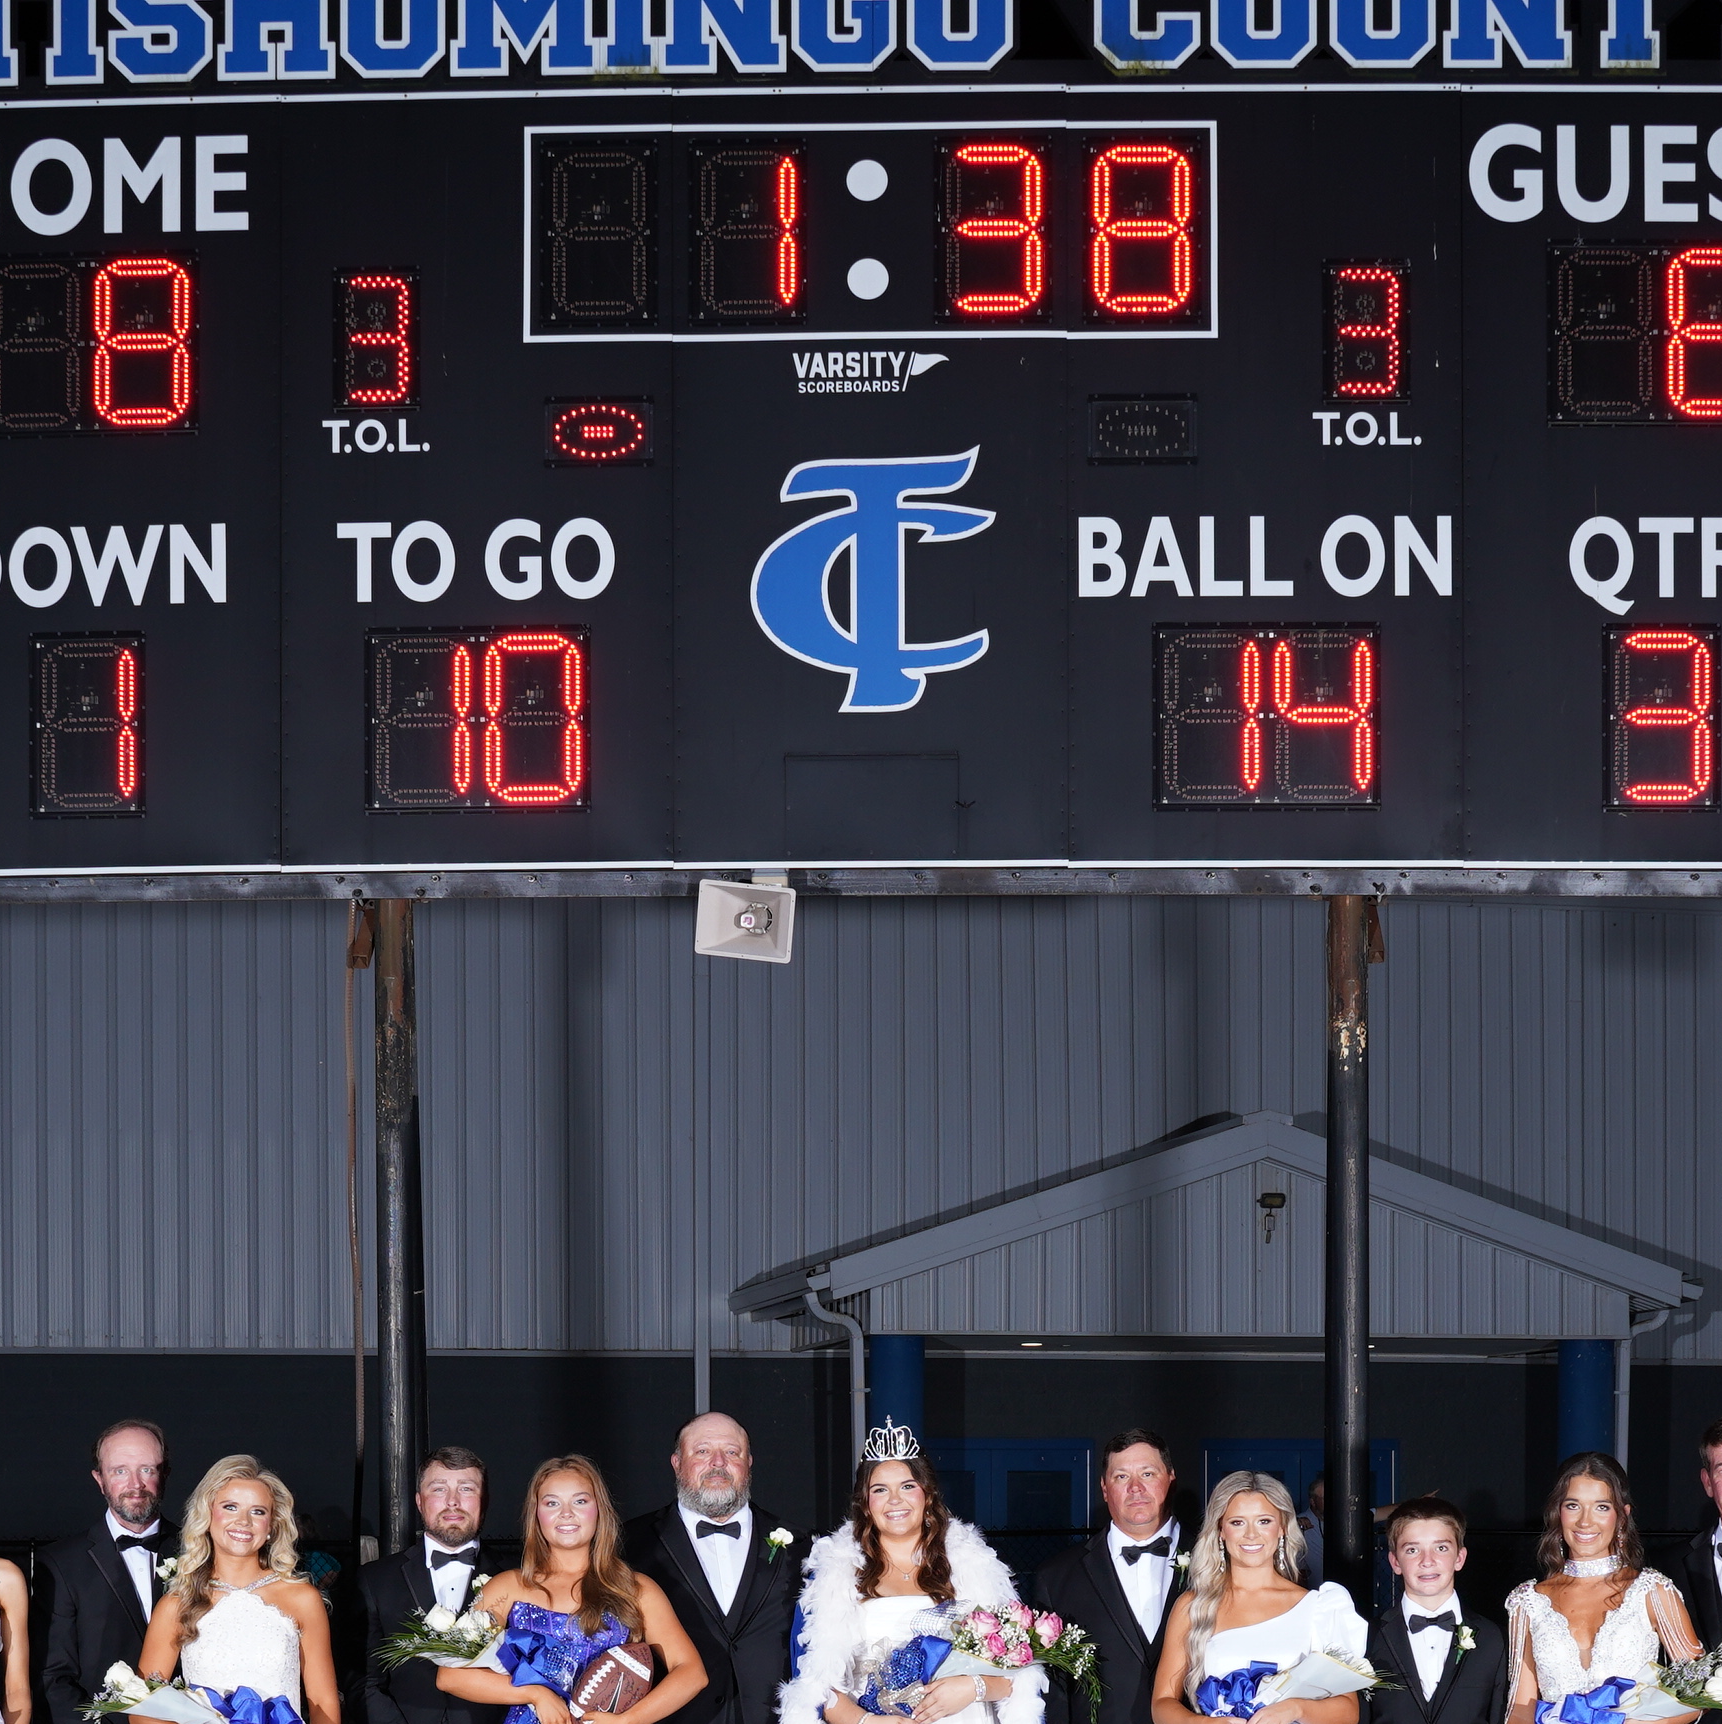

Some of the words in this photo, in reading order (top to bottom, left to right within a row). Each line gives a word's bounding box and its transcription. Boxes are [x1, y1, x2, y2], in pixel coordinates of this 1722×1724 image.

[776, 144, 1193, 314] 1:38
[92, 257, 191, 427] 8
[350, 275, 409, 403] 3
[792, 351, 906, 378] VARSITY
[797, 380, 900, 394] SCOREBOARDS
[1339, 268, 1400, 395] 3
[321, 418, 431, 454] T.O.L.
[1312, 411, 1422, 446] T.O.L.
[336, 520, 456, 603] TO
[484, 517, 616, 601] GO
[1077, 515, 1294, 598] BALL
[1320, 514, 1453, 598] ON
[117, 648, 137, 798] 1
[449, 632, 584, 806] 10
[1239, 639, 1374, 791] 14
[1624, 630, 1712, 804] 3
